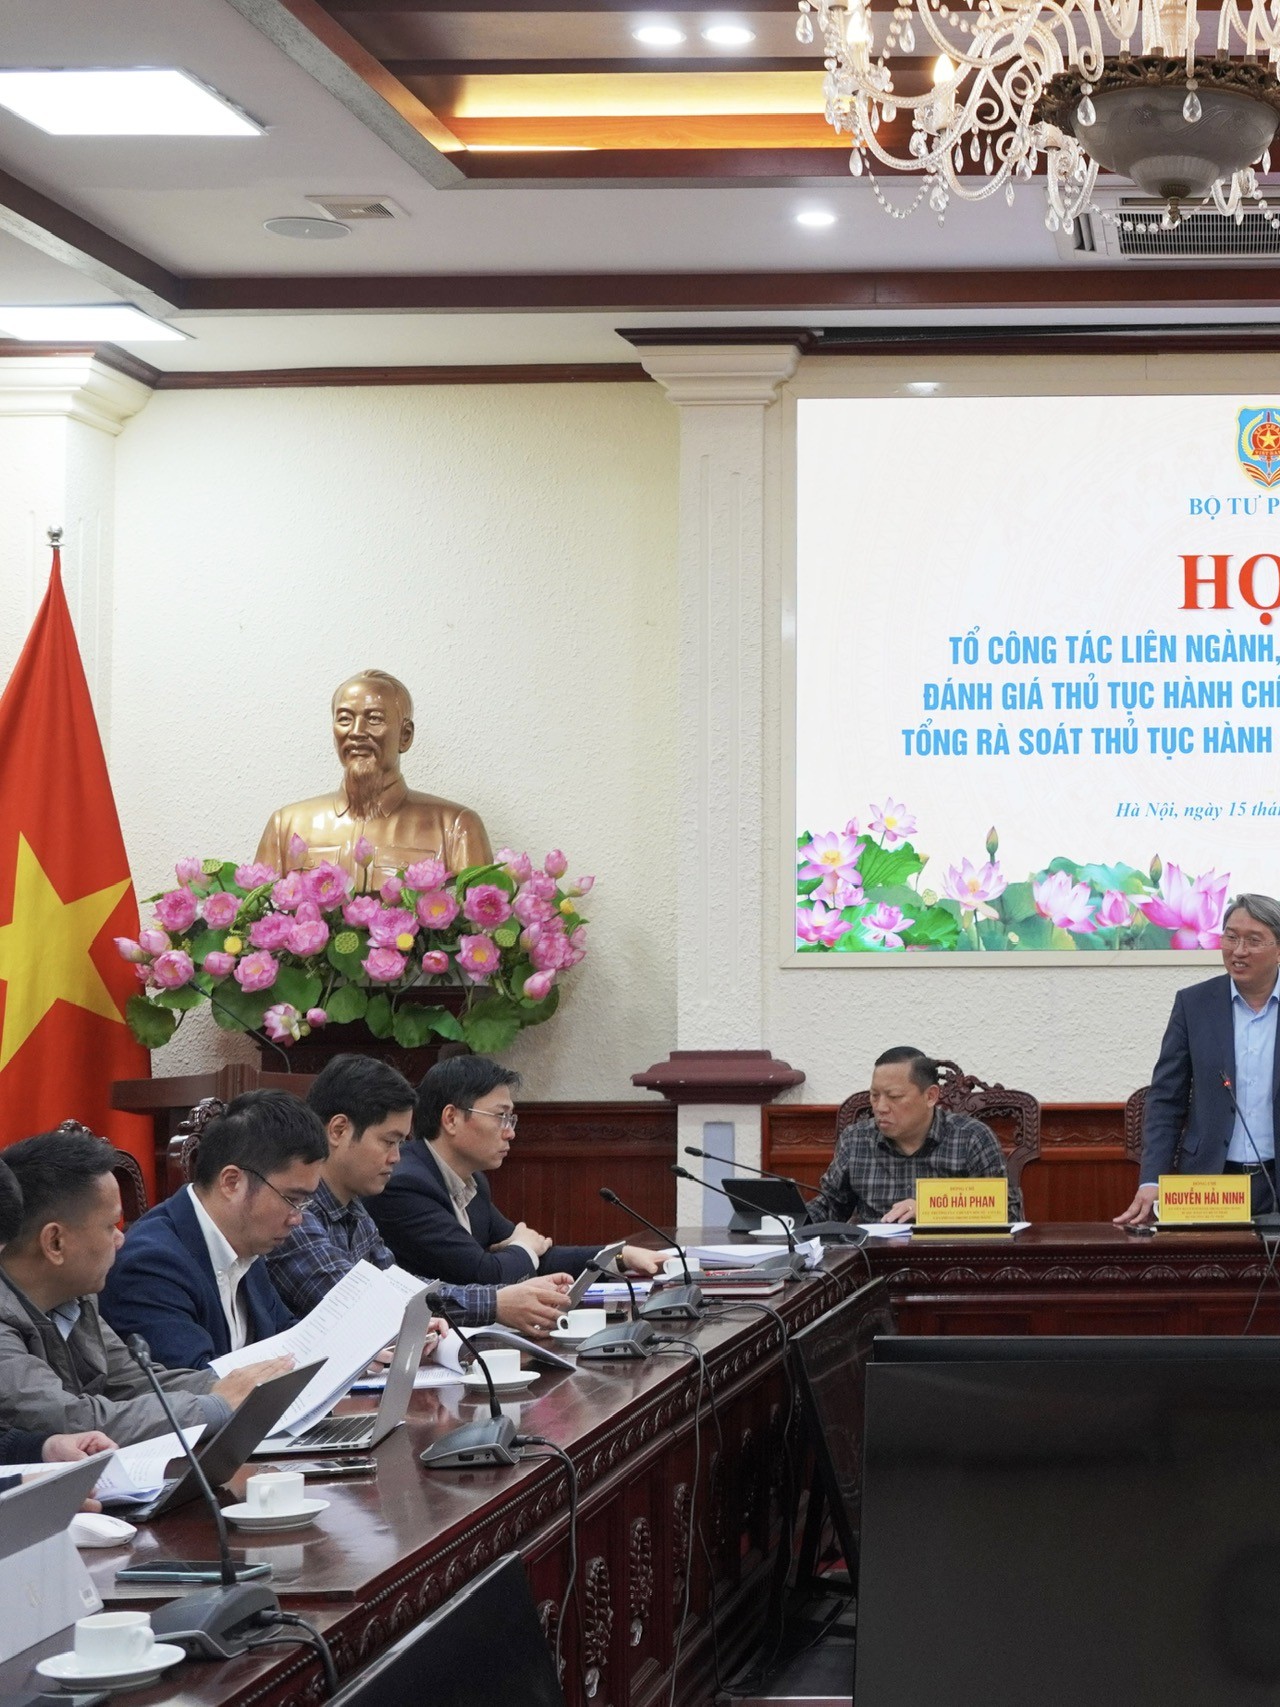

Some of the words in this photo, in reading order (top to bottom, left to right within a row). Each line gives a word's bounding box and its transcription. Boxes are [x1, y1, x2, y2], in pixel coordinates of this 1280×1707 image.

[1189, 494, 1221, 520] BỘ
[1227, 495, 1262, 515] TƯ
[949, 625, 980, 665] TỔ
[988, 630, 1057, 665] CÔNG
[1065, 630, 1112, 664] TÁC
[1121, 629, 1177, 663] LIÊN
[1185, 629, 1280, 665] NGÀNH,
[923, 677, 992, 711] ĐÁNH
[1002, 676, 1043, 710] GIÁ
[1051, 673, 1099, 710] THỦ
[1107, 681, 1155, 715] TỤC
[1163, 675, 1233, 709] HÀNH
[901, 718, 968, 756] TỔNG
[976, 723, 1010, 755] RÀ
[1019, 722, 1083, 755] SOÁT
[1091, 718, 1138, 754] THỦ
[1147, 727, 1195, 760] TỤC
[1203, 721, 1273, 753] HÀNH
[1115, 802, 1140, 818] Hà
[1145, 802, 1179, 821] Nội,
[1184, 803, 1223, 820] ngày
[1229, 801, 1247, 817] 15
[929, 1194, 949, 1208] NGÔ
[951, 1192, 967, 1208] HẢI
[969, 1195, 995, 1208] PHAN
[1164, 1187, 1201, 1205] NGUYỄN
[1204, 1187, 1219, 1205] HẢI
[1222, 1191, 1245, 1204] NINH
